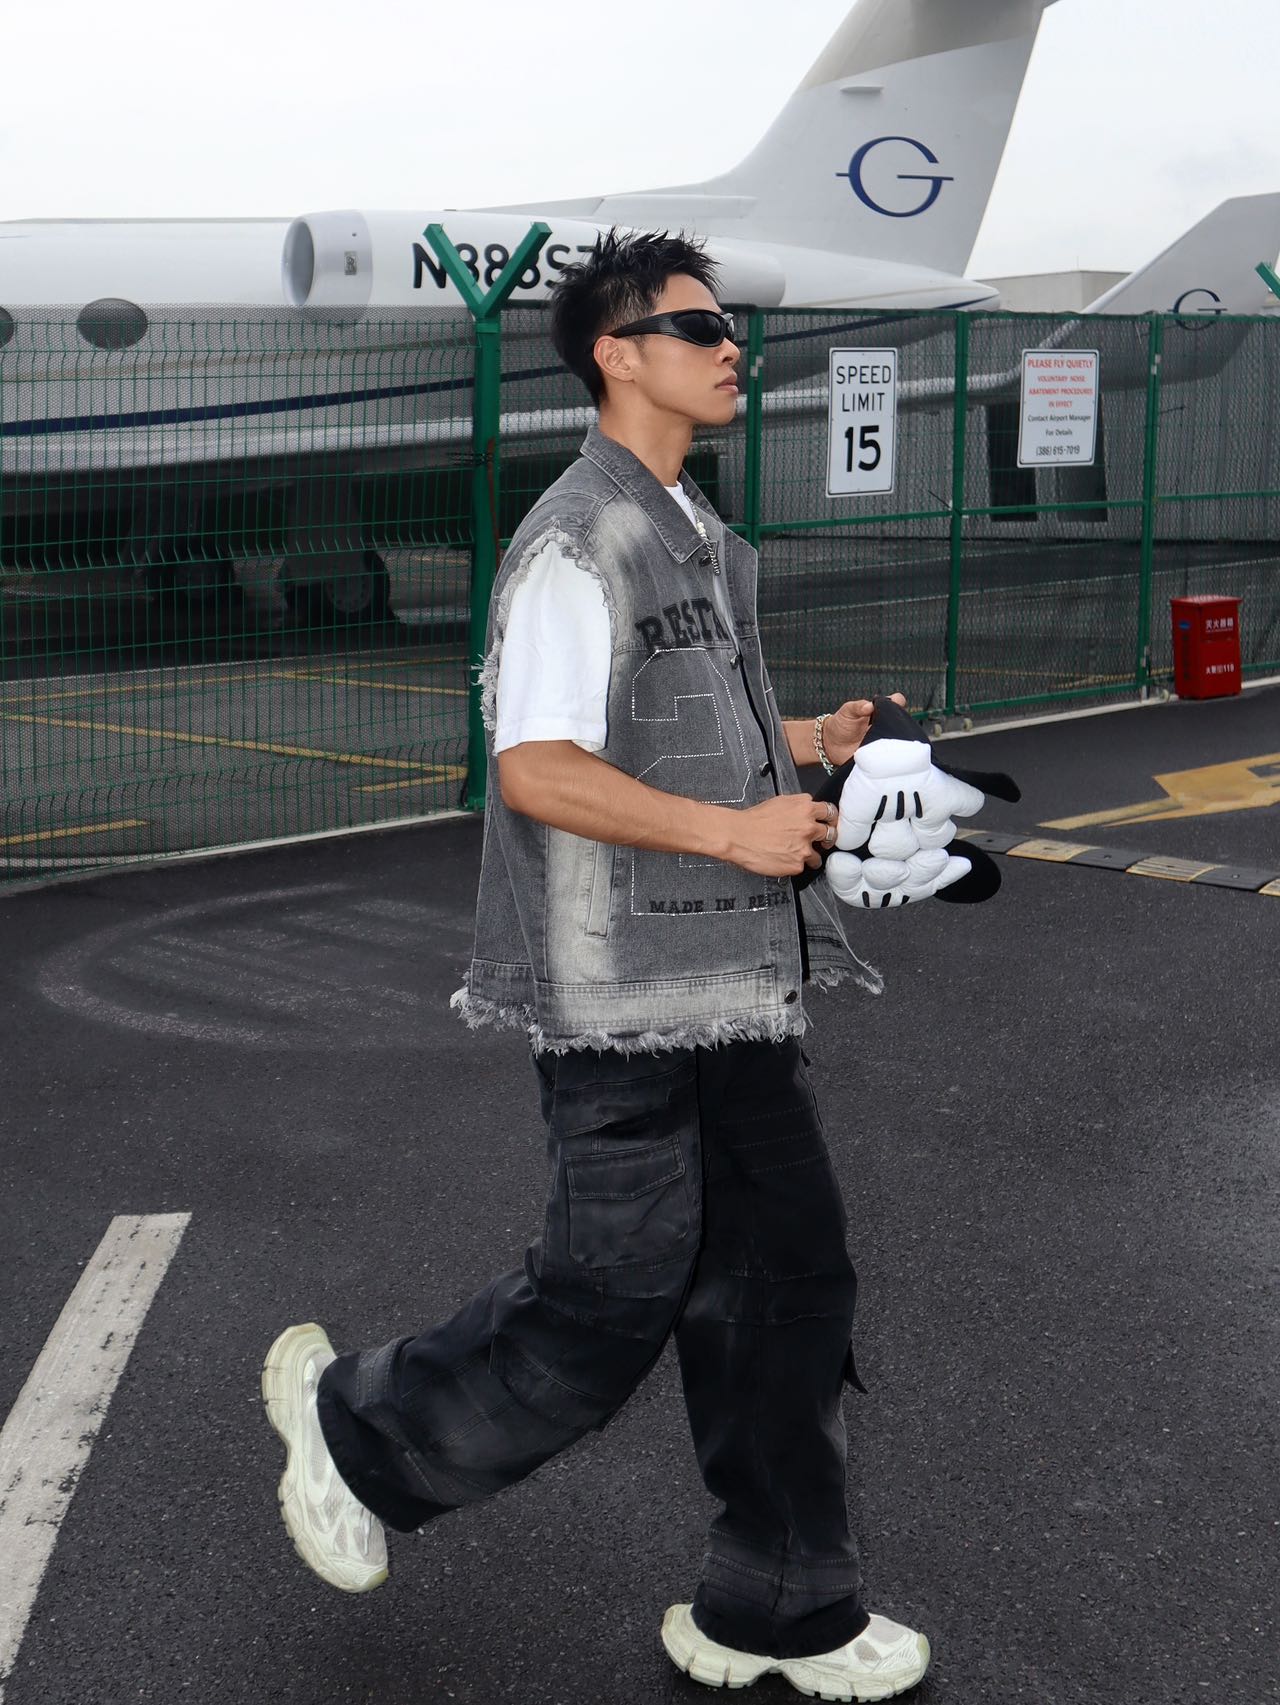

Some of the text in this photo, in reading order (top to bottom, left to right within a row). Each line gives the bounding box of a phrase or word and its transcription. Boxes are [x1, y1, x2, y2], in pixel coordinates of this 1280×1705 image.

[835, 136, 954, 218] G
[412, 242, 598, 290] N888S
[1027, 358, 1093, 369] PLEASE FLY QUIETLY
[836, 365, 892, 385] SPEED
[842, 392, 886, 412] LIMIT
[1048, 400, 1055, 408] IN
[1027, 414, 1091, 423] Contact Airport Manager
[1055, 428, 1073, 436] Details
[844, 425, 881, 473] 15
[650, 899, 704, 914] MADE
[715, 897, 736, 911] IN
